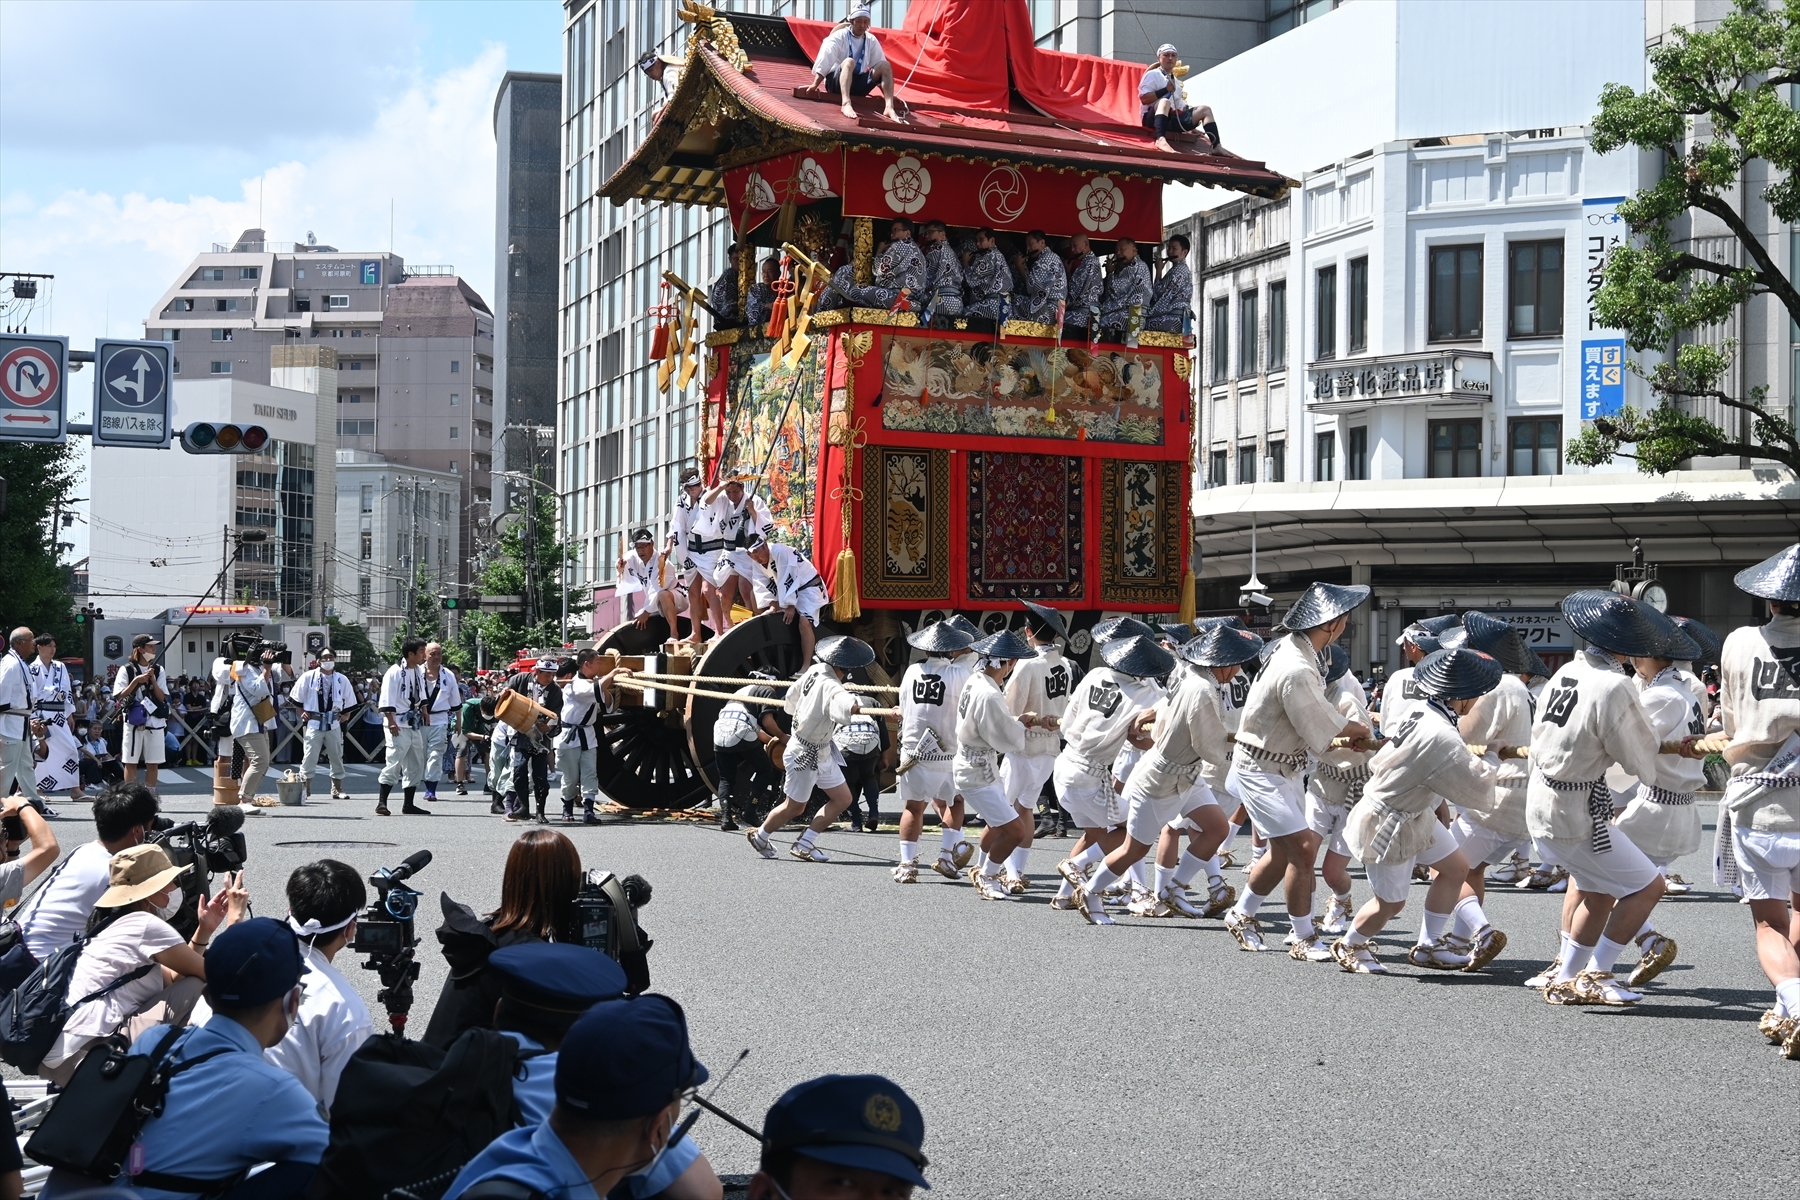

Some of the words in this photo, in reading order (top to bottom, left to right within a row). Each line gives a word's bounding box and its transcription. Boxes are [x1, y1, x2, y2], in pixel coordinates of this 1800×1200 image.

[1604, 348, 1619, 383] すぐ
[1313, 362, 1445, 399] 池善化粧品店
[1585, 347, 1601, 417] 買えます
[102, 416, 162, 432] 路線バスを除く
[276, 407, 298, 421] SEED
[1508, 615, 1561, 625] メガネスーパー
